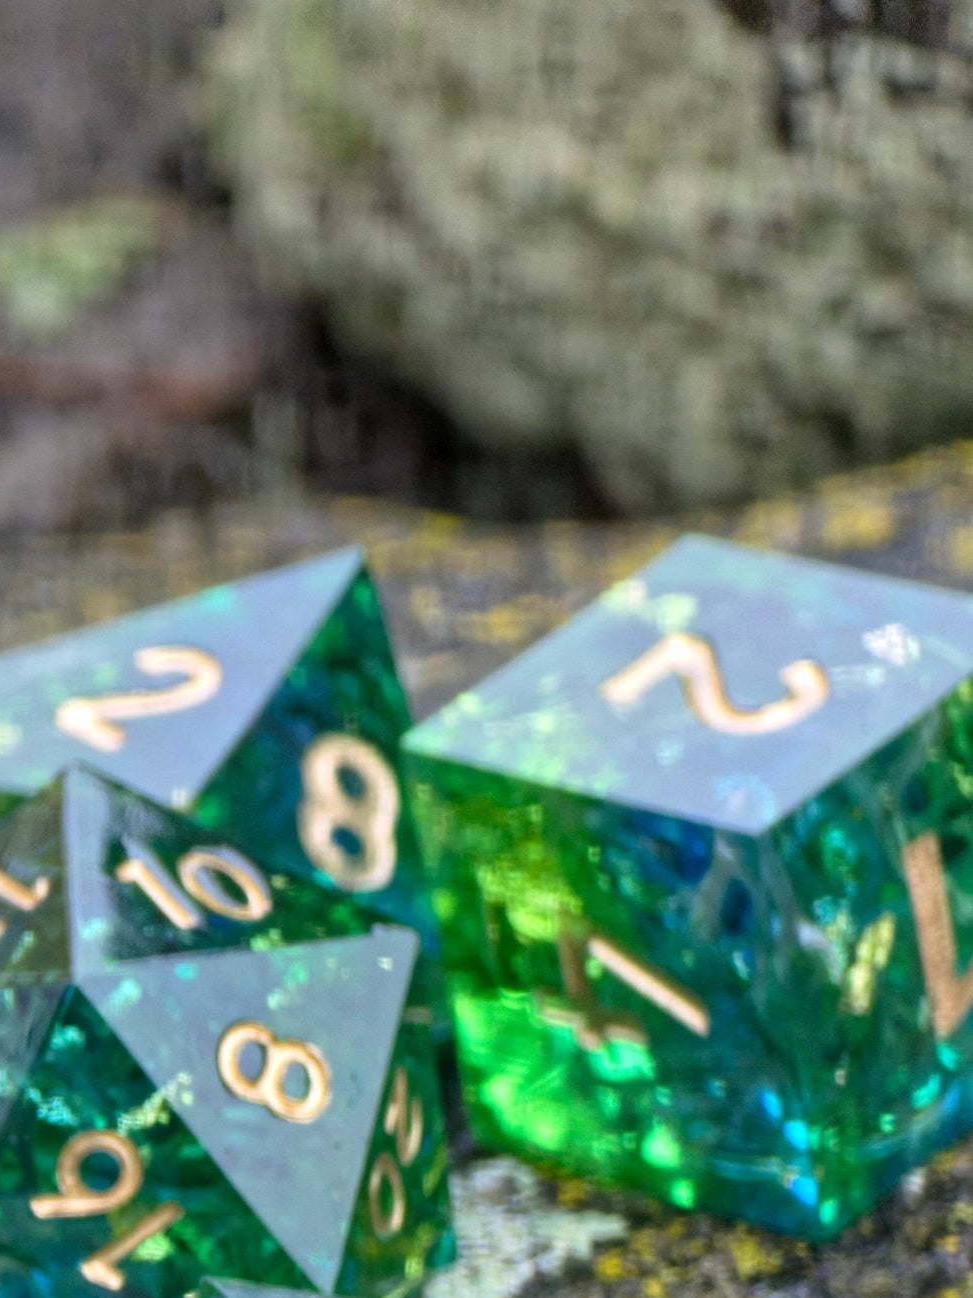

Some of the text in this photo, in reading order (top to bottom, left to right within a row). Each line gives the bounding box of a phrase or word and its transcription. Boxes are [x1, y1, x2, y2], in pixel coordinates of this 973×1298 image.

[55, 646, 221, 752] 2
[600, 633, 828, 735] 2
[297, 734, 400, 892] 8
[117, 847, 272, 930] 10
[217, 1020, 331, 1124] 8
[30, 1130, 185, 1291] 16
